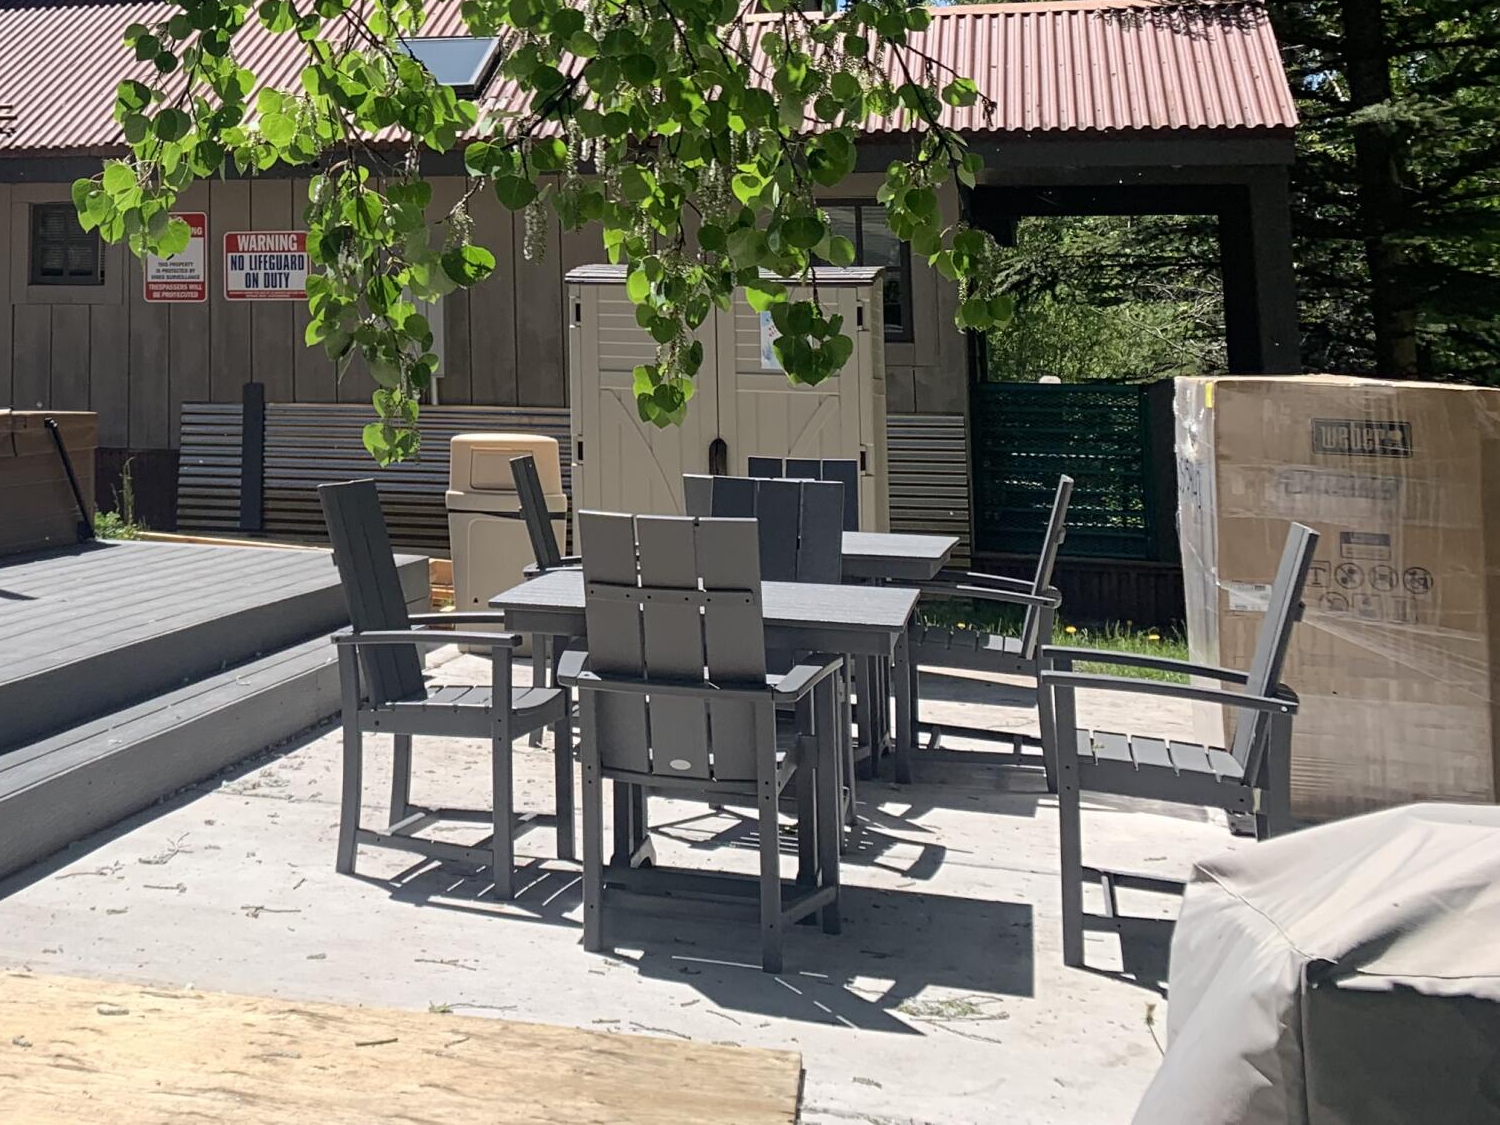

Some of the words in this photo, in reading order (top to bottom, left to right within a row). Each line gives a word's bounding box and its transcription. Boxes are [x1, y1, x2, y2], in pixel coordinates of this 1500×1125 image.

[237, 234, 297, 252] WARNING
[231, 255, 244, 271] NO
[249, 255, 304, 271] LIFEGUARD
[149, 283, 188, 291] TRESPASSERS
[189, 283, 203, 291] WILL
[245, 272, 259, 288] ON
[264, 272, 290, 288] DUTY
[1321, 424, 1384, 450] weber
